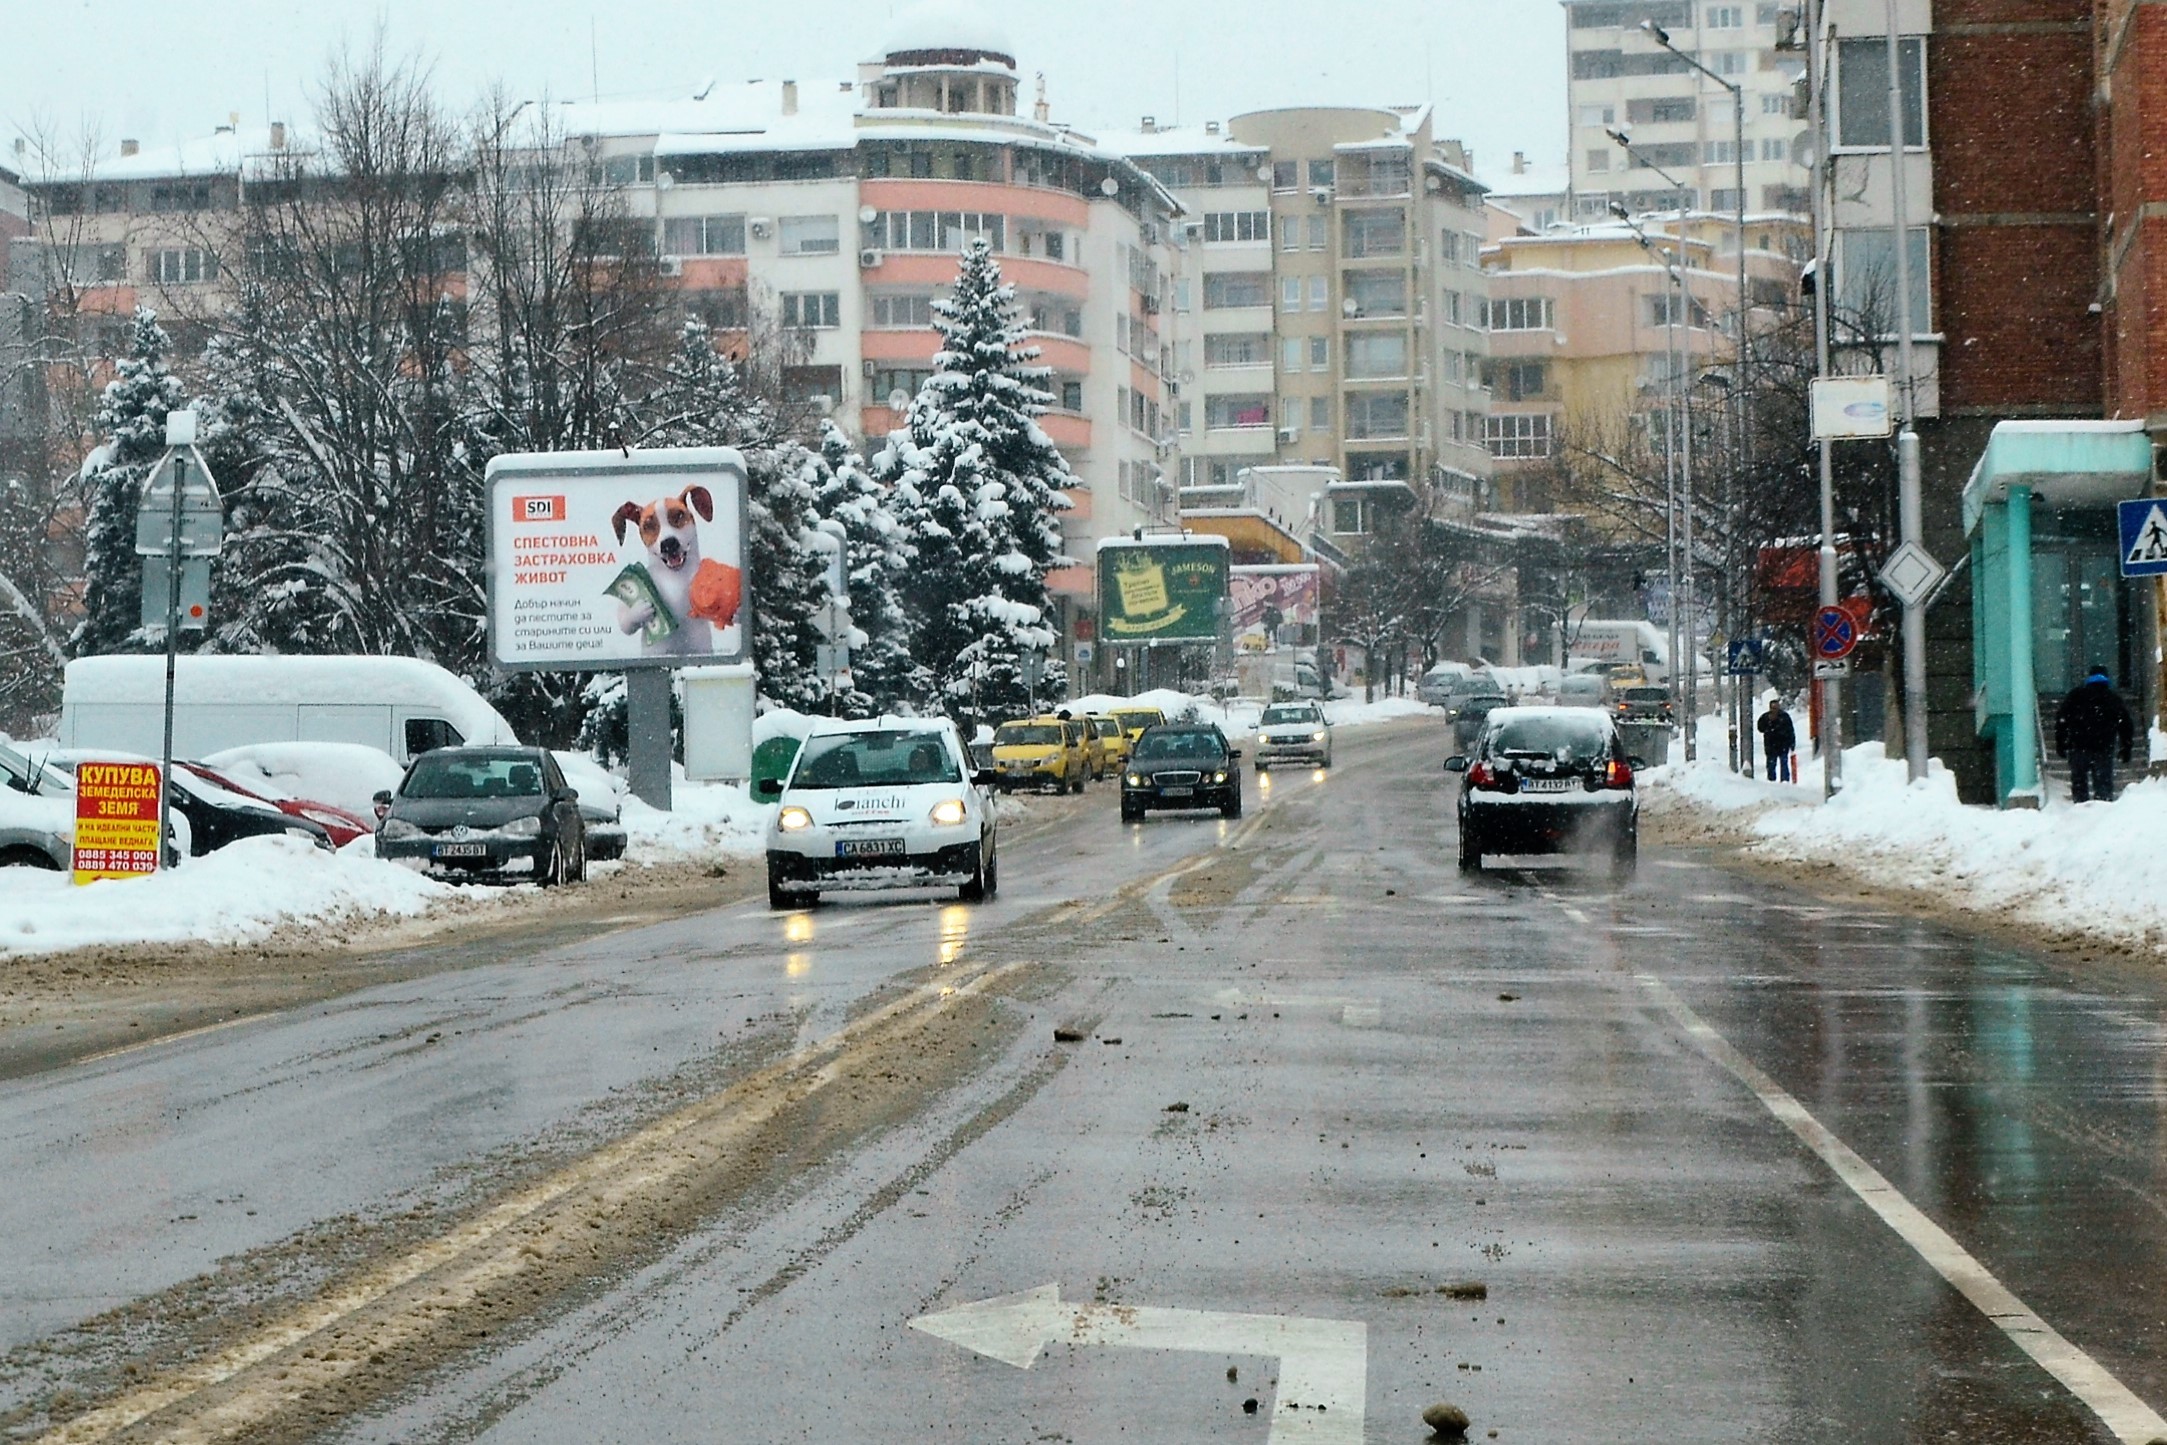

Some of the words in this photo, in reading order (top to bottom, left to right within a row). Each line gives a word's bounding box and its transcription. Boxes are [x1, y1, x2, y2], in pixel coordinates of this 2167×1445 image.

[527, 501, 551, 513] SDI
[514, 535, 598, 549] СПЕСТОВНА
[514, 552, 617, 567] ЗАСТРАХОВКА
[1171, 562, 1216, 576] JAMESON
[515, 571, 567, 584] ЖИВОТ
[514, 599, 548, 610] Добър
[550, 599, 581, 607] начин
[514, 615, 527, 625] да
[529, 613, 578, 623] пестите
[581, 613, 592, 621] за
[579, 627, 591, 635] си
[593, 626, 612, 634] или
[515, 643, 527, 651] за
[529, 640, 574, 650] Вашите
[576, 639, 603, 650] деца!
[81, 766, 157, 786] КУПУВА
[79, 786, 157, 799] ЗЕМЕДЕЛСКА
[98, 801, 139, 815] ЗЕМЯ
[96, 824, 131, 833] ИДЕАЛНИ
[133, 825, 156, 833] ЧАСТИ
[79, 837, 117, 846] ПЛАЩАНЕ
[119, 837, 154, 846] ВЕДНАГА
[844, 842, 858, 854] CA
[860, 842, 885, 853] 6831
[888, 841, 902, 852] XC
[78, 850, 106, 859] 0885
[109, 850, 130, 860] 345
[133, 851, 154, 861] 000
[78, 860, 105, 870] 0889
[108, 861, 129, 870] 470
